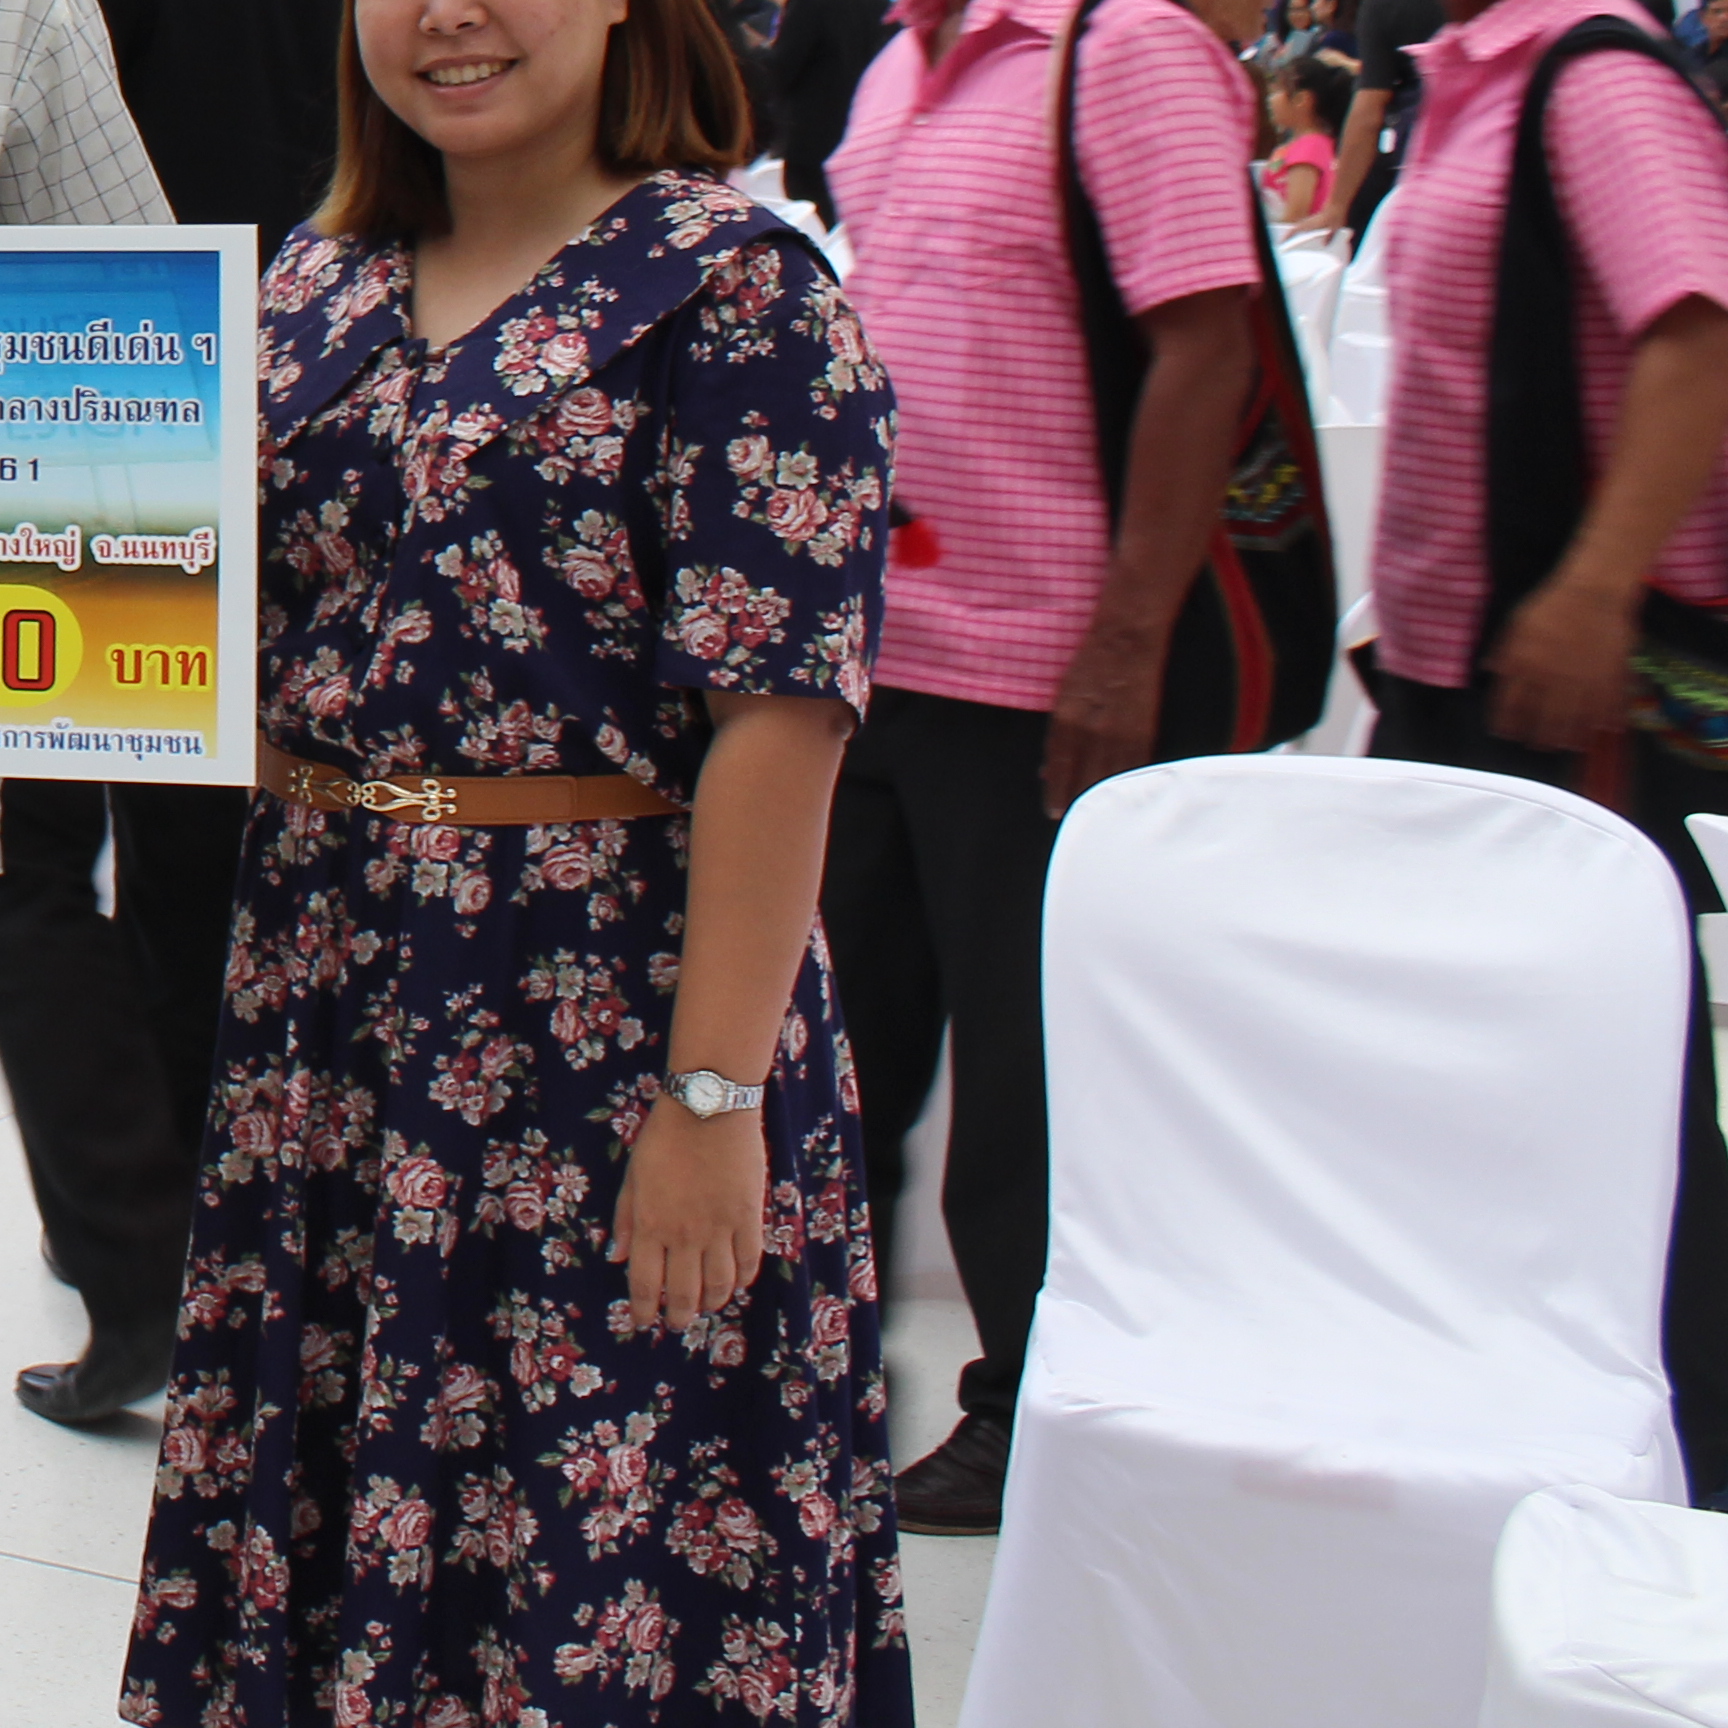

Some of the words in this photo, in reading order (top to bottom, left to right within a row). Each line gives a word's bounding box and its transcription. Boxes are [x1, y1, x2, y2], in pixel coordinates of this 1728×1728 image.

[96, 530, 211, 569] จ.นนทบุรี
[110, 647, 209, 687] บาท
